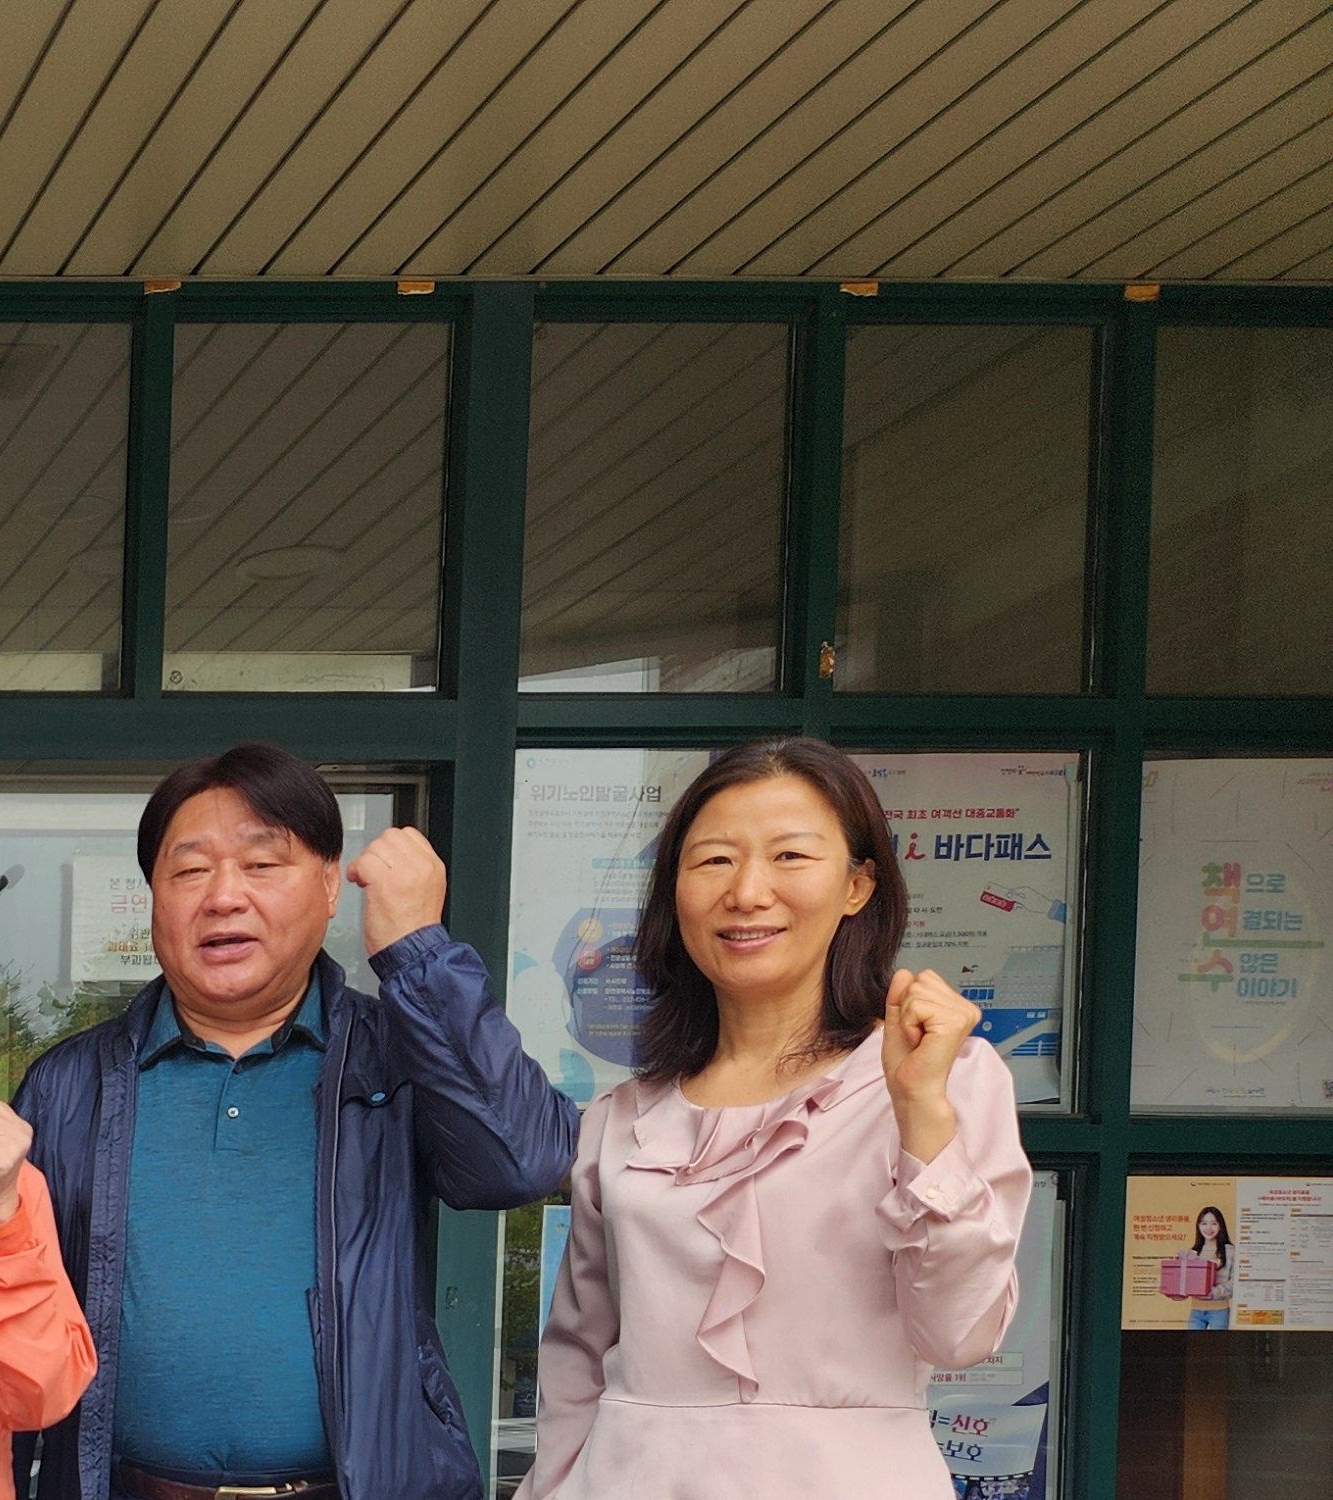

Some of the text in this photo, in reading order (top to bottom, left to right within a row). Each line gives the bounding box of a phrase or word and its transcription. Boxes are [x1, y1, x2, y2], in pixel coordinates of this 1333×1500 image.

[530, 784, 662, 803] 위기노인발굴사업
[906, 808, 928, 820] 최초
[931, 808, 962, 820] 여객선
[934, 832, 1052, 862] 바다패스
[110, 894, 148, 914] 금연
[1237, 978, 1297, 999] 이야기
